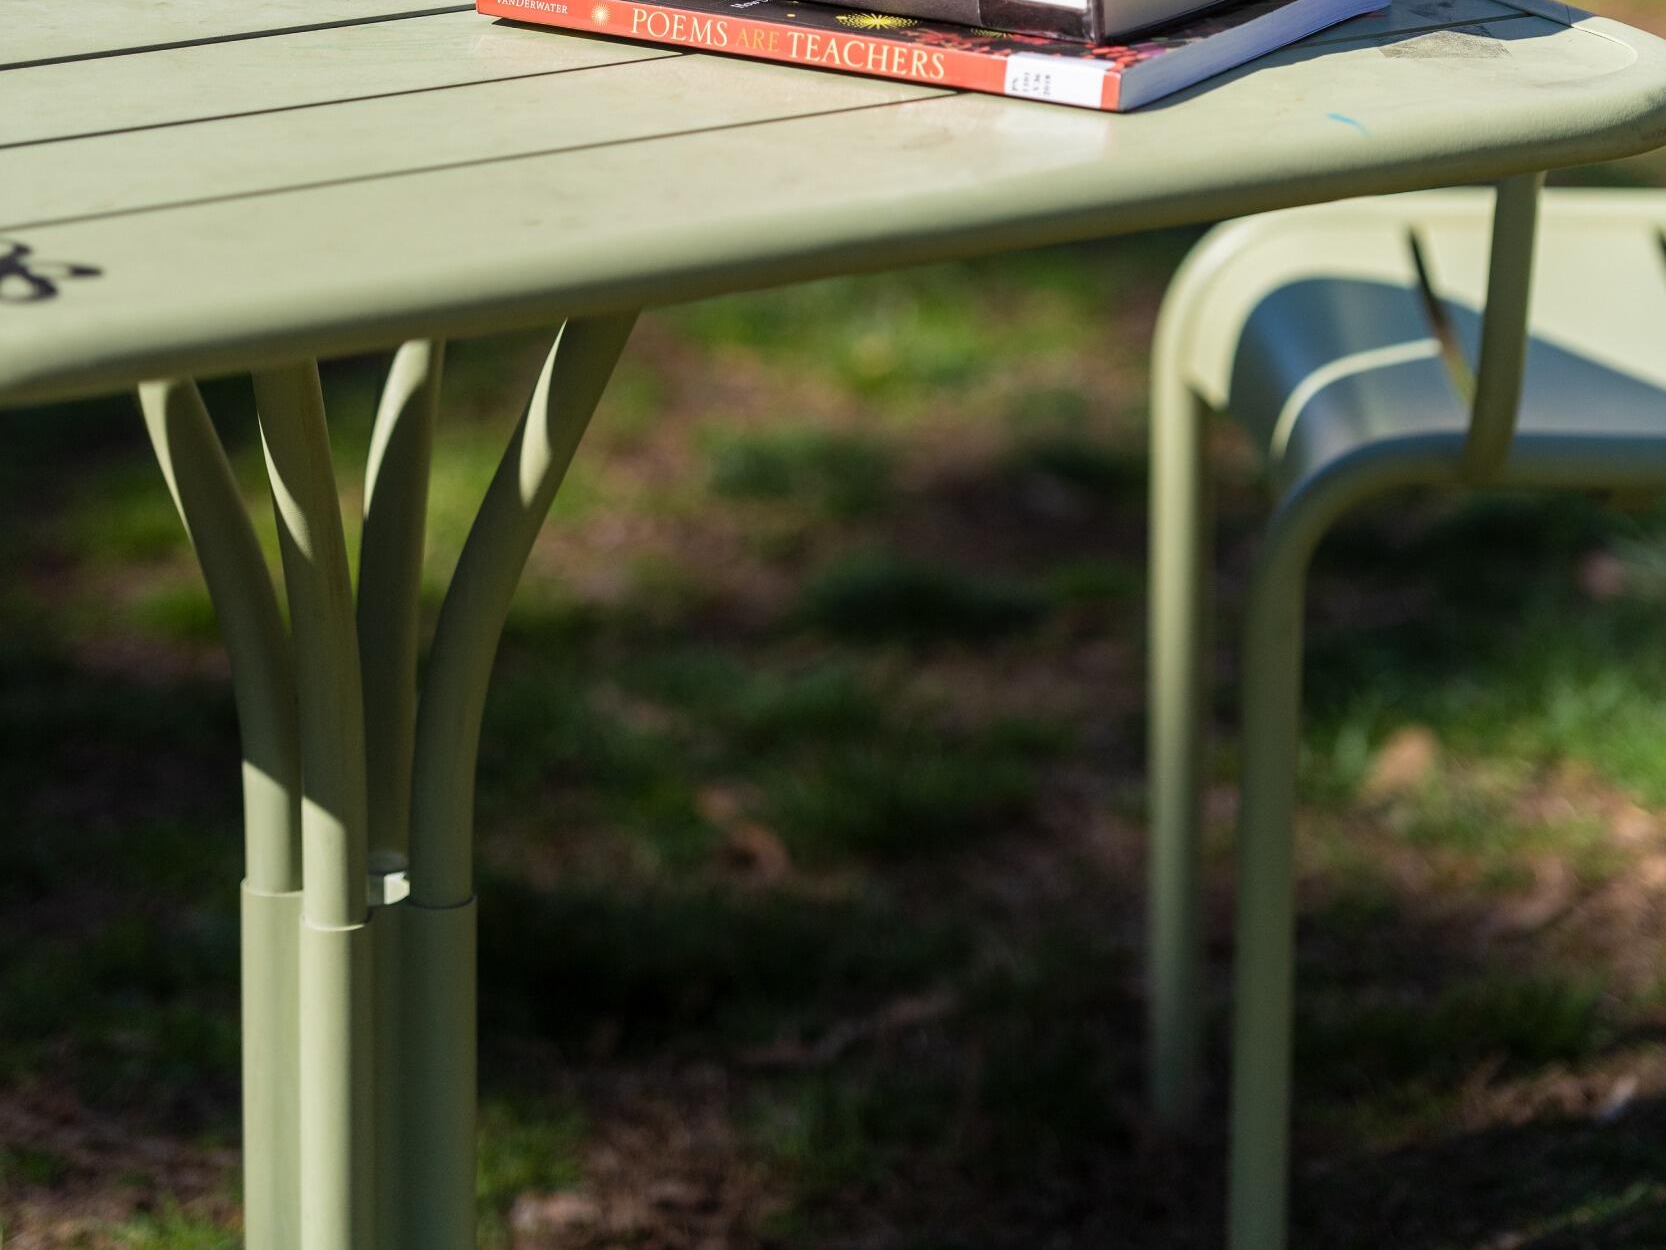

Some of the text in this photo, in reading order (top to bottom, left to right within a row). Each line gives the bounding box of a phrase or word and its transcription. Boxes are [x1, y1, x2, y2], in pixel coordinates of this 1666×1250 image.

[631, 7, 945, 80] POEMS ARE TEACHERS
